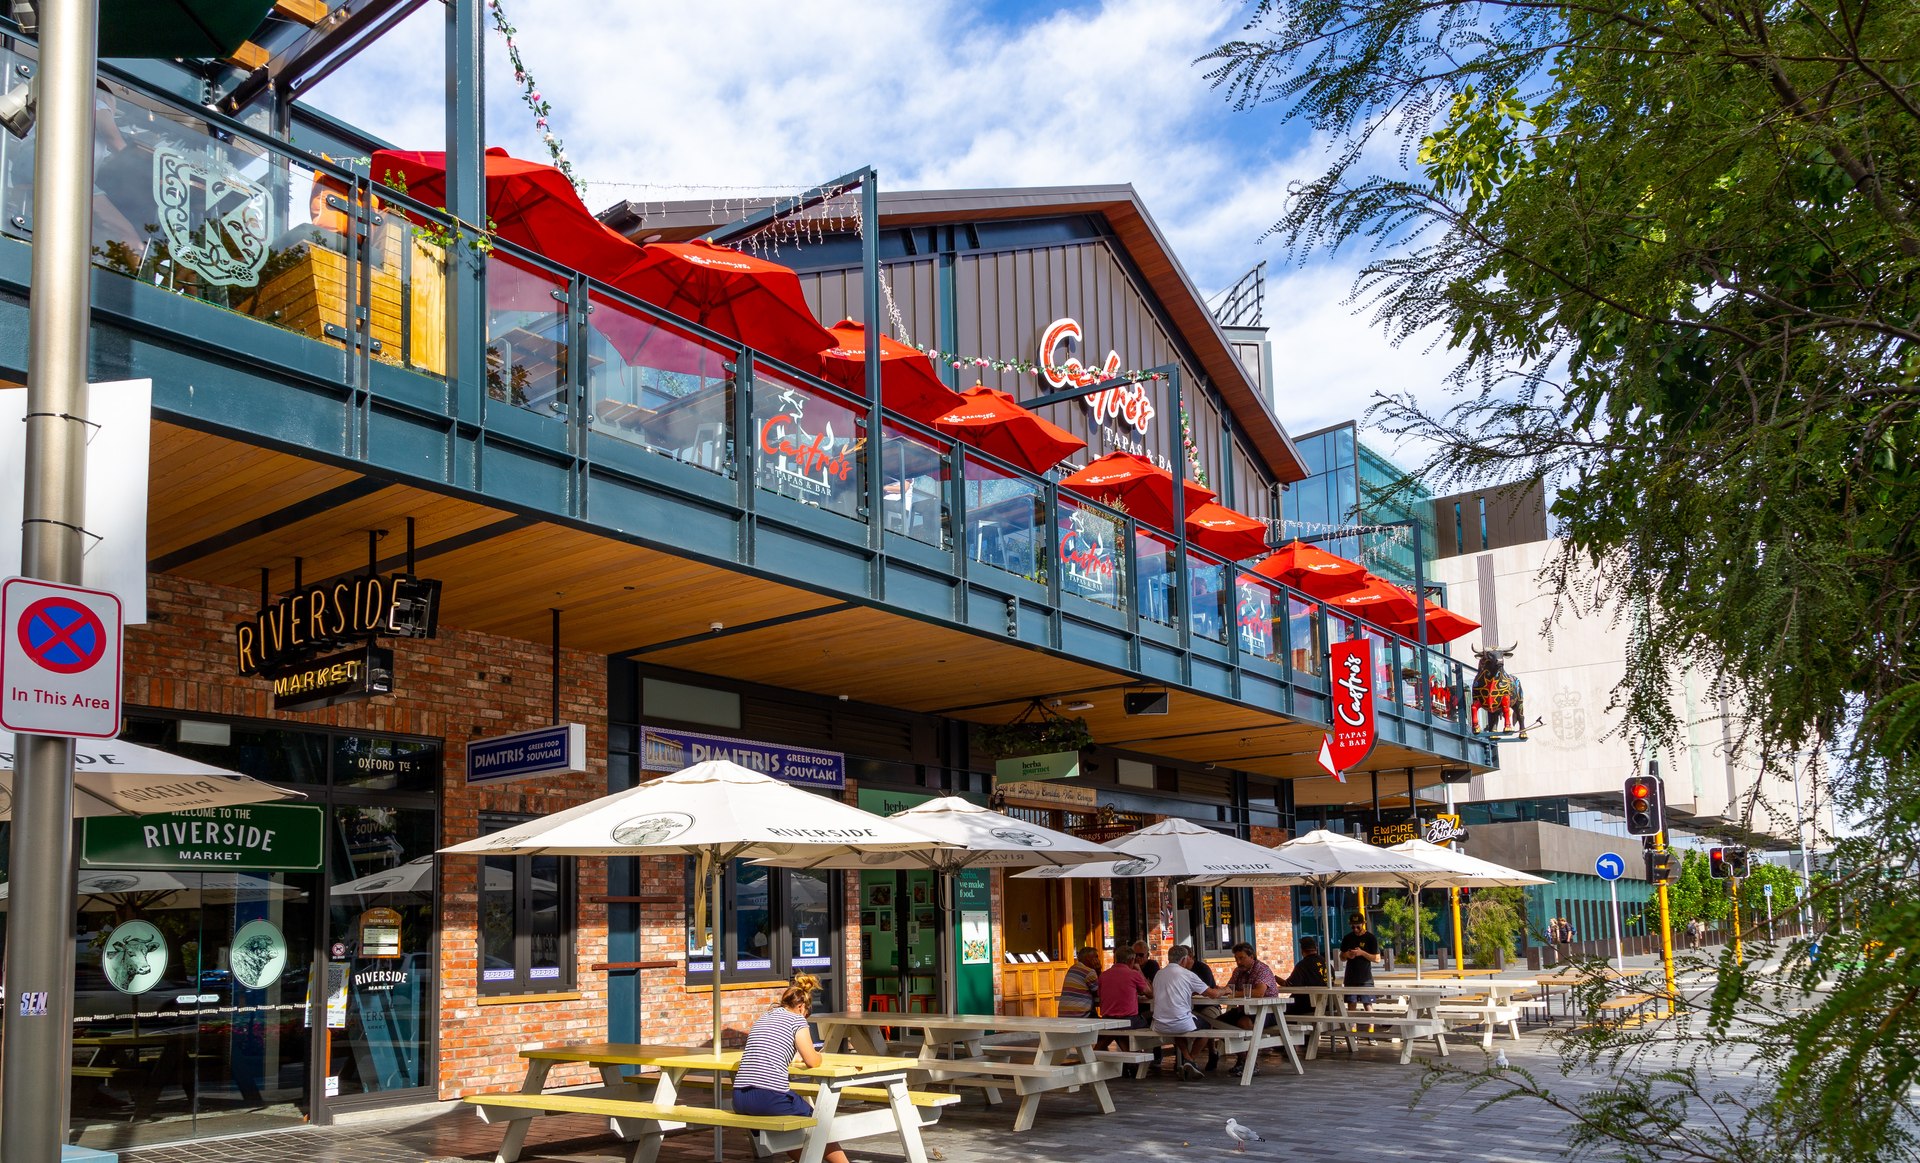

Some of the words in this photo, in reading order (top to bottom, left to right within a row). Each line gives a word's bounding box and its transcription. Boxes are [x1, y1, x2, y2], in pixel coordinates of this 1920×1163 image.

[761, 414, 853, 480] Castro's
[1104, 426, 1142, 456] TAPAS
[1146, 449, 1155, 463] &
[1158, 454, 1173, 473] BA
[775, 469, 803, 486] TAPAS
[806, 482, 811, 490] &
[815, 484, 832, 496] BAR
[1060, 531, 1113, 578] Castro's
[239, 579, 406, 672] RIVERSIDE
[274, 661, 358, 695] MARKET
[1338, 654, 1368, 727] Castro's
[12, 687, 28, 701] In
[34, 689, 67, 705] This
[72, 694, 110, 710] Area
[1339, 731, 1367, 739] TAPAS
[545, 740, 559, 748] FOOD
[1349, 739, 1366, 747] BAR
[475, 748, 524, 768] DIMITRIS
[527, 748, 561, 761] SOUVLAKI
[692, 743, 780, 772] DIMITRIS
[786, 753, 811, 764] GREEK
[812, 756, 833, 766] FOOD
[358, 758, 395, 770] OXFORD
[1022, 761, 1041, 769] herba
[1022, 765, 1050, 776] gourmet
[784, 765, 836, 781] SOUVLAKI
[884, 800, 909, 812] herba
[219, 808, 231, 819] TO
[235, 809, 251, 819] THE
[766, 827, 878, 837] RIVERSIDE
[1373, 823, 1414, 835] EMPIRE
[143, 822, 276, 852] RIVERSIDE
[1371, 833, 1418, 844] CHICKEN
[179, 851, 242, 860] MARKET
[968, 880, 984, 888] make
[355, 971, 407, 985] RIVERSIDE
